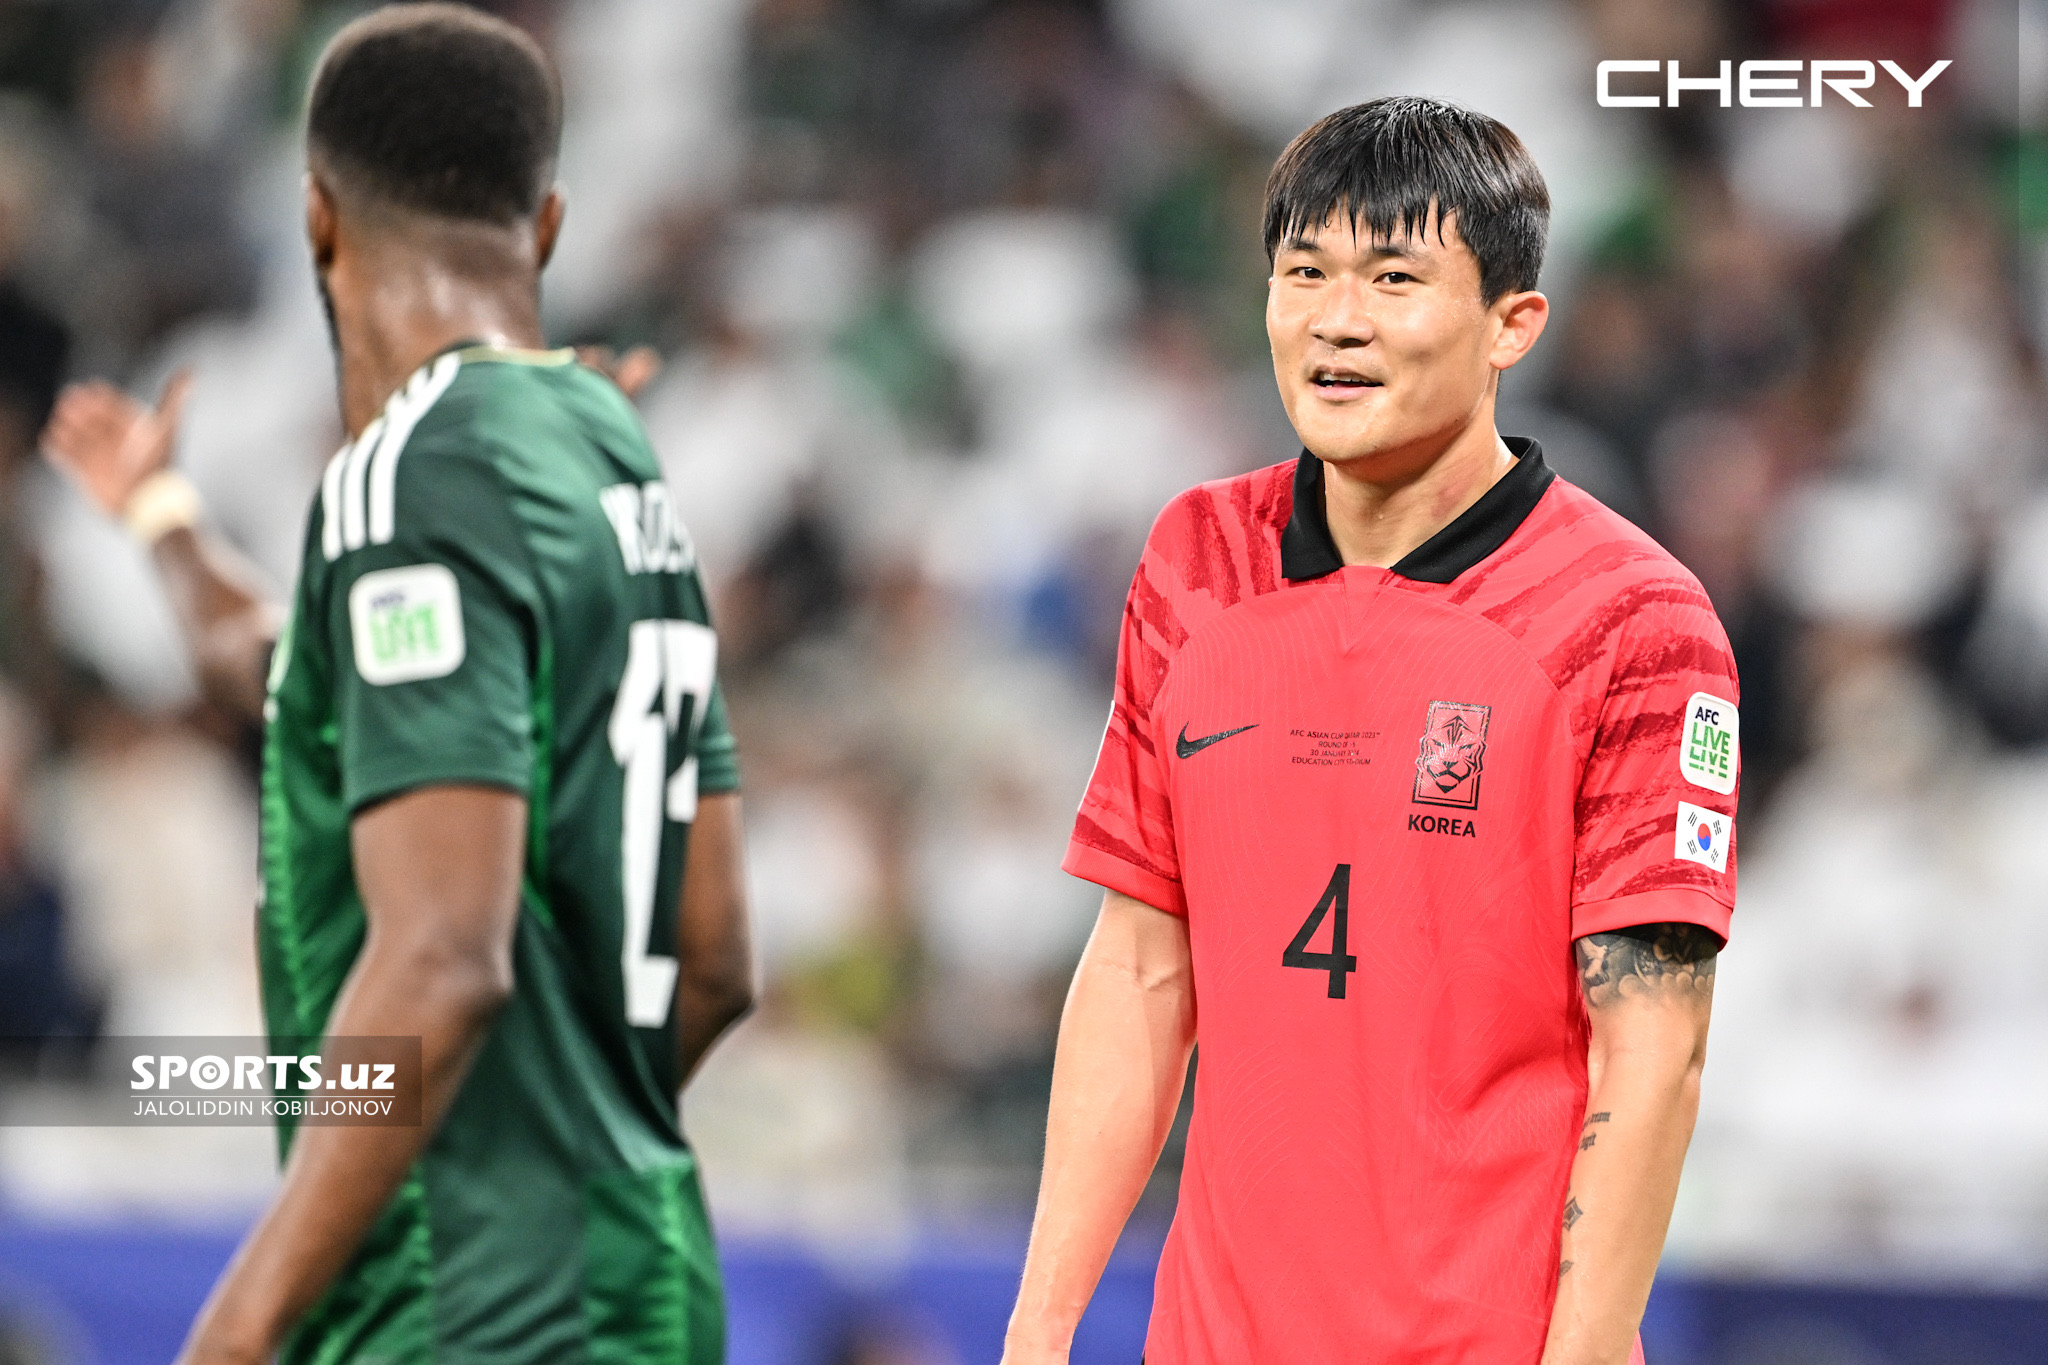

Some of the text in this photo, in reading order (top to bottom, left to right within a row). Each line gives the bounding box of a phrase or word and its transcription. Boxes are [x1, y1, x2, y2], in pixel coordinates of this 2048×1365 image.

[1694, 705, 1720, 726] AFC
[1290, 729, 1305, 737] AFC
[1307, 731, 1329, 739] ASIAN
[1691, 721, 1731, 756] LIVE
[1291, 756, 1333, 766] EDUCATION
[1407, 814, 1476, 838] KOREA
[1281, 863, 1358, 1000] 4
